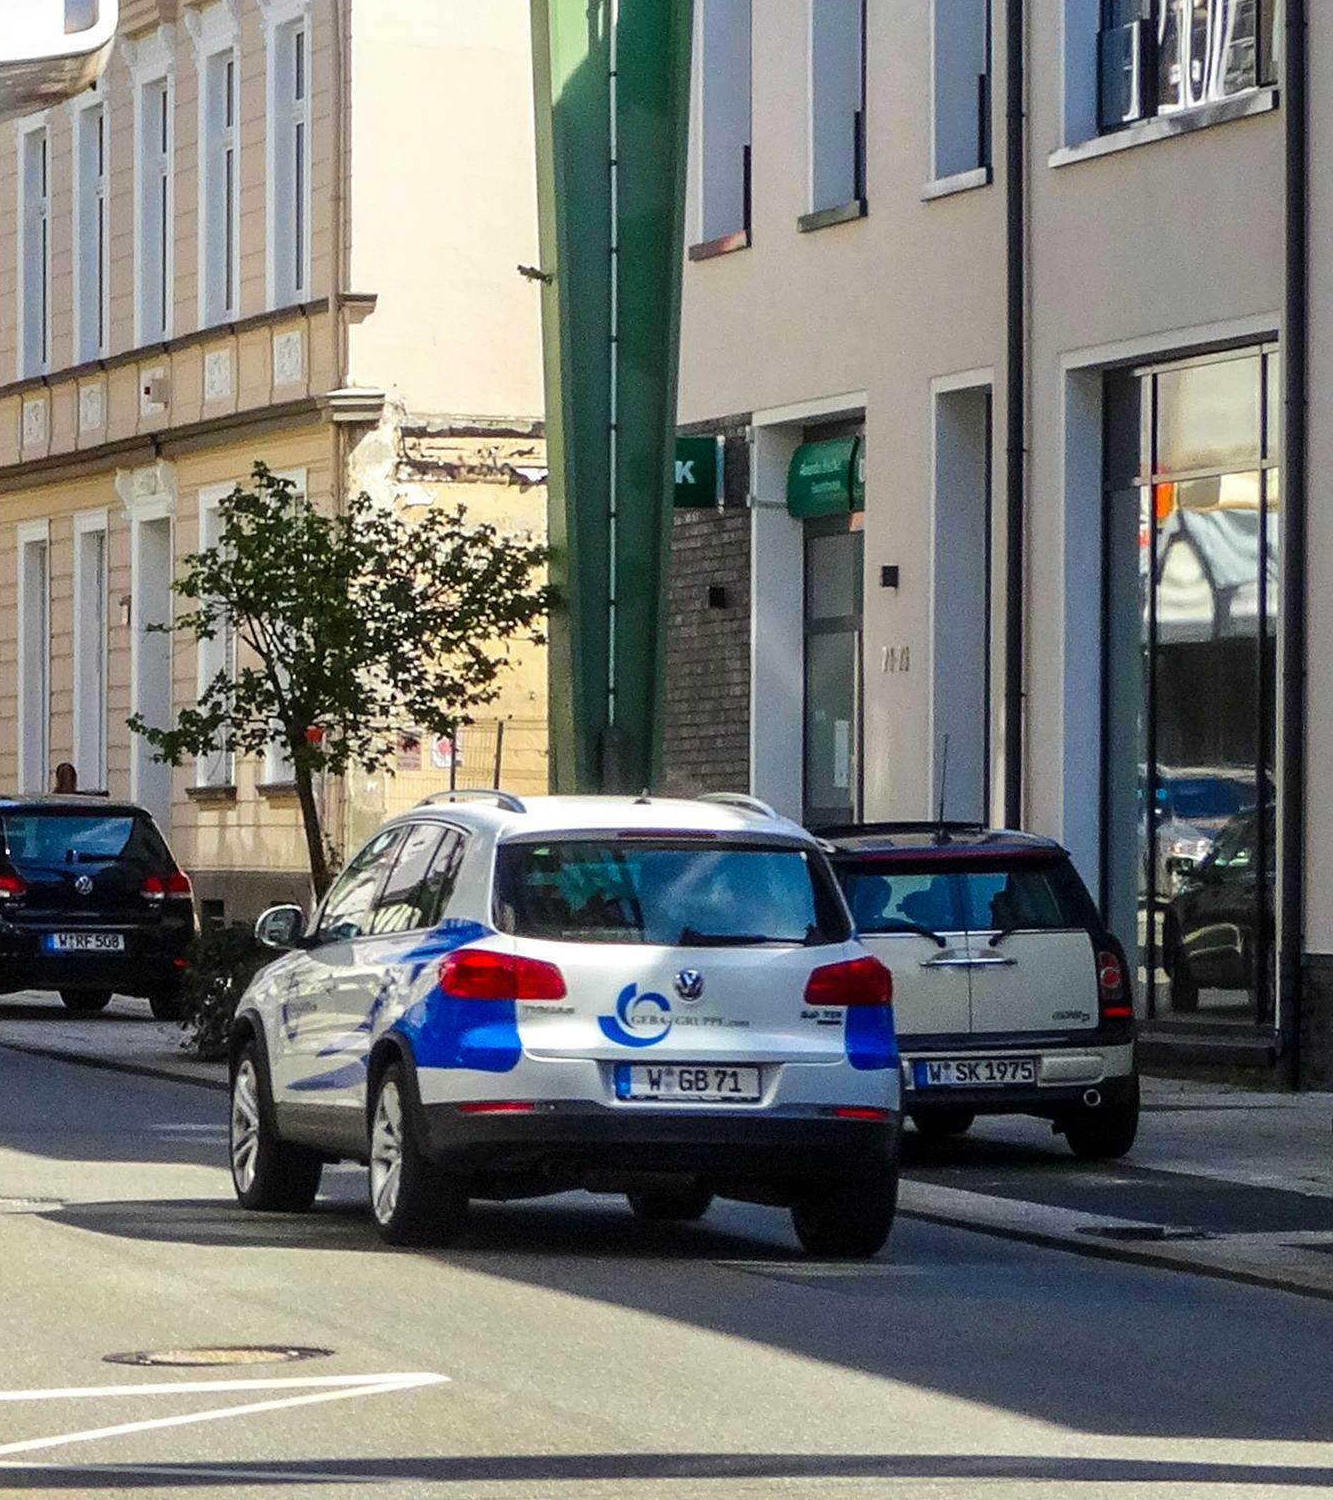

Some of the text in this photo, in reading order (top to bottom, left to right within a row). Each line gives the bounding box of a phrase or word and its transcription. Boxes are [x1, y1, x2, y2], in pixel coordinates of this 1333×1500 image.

[678, 1069, 709, 1092] GB
[716, 1071, 742, 1092] 71
[955, 1063, 981, 1082] SK
[985, 1061, 1033, 1081] 1975
